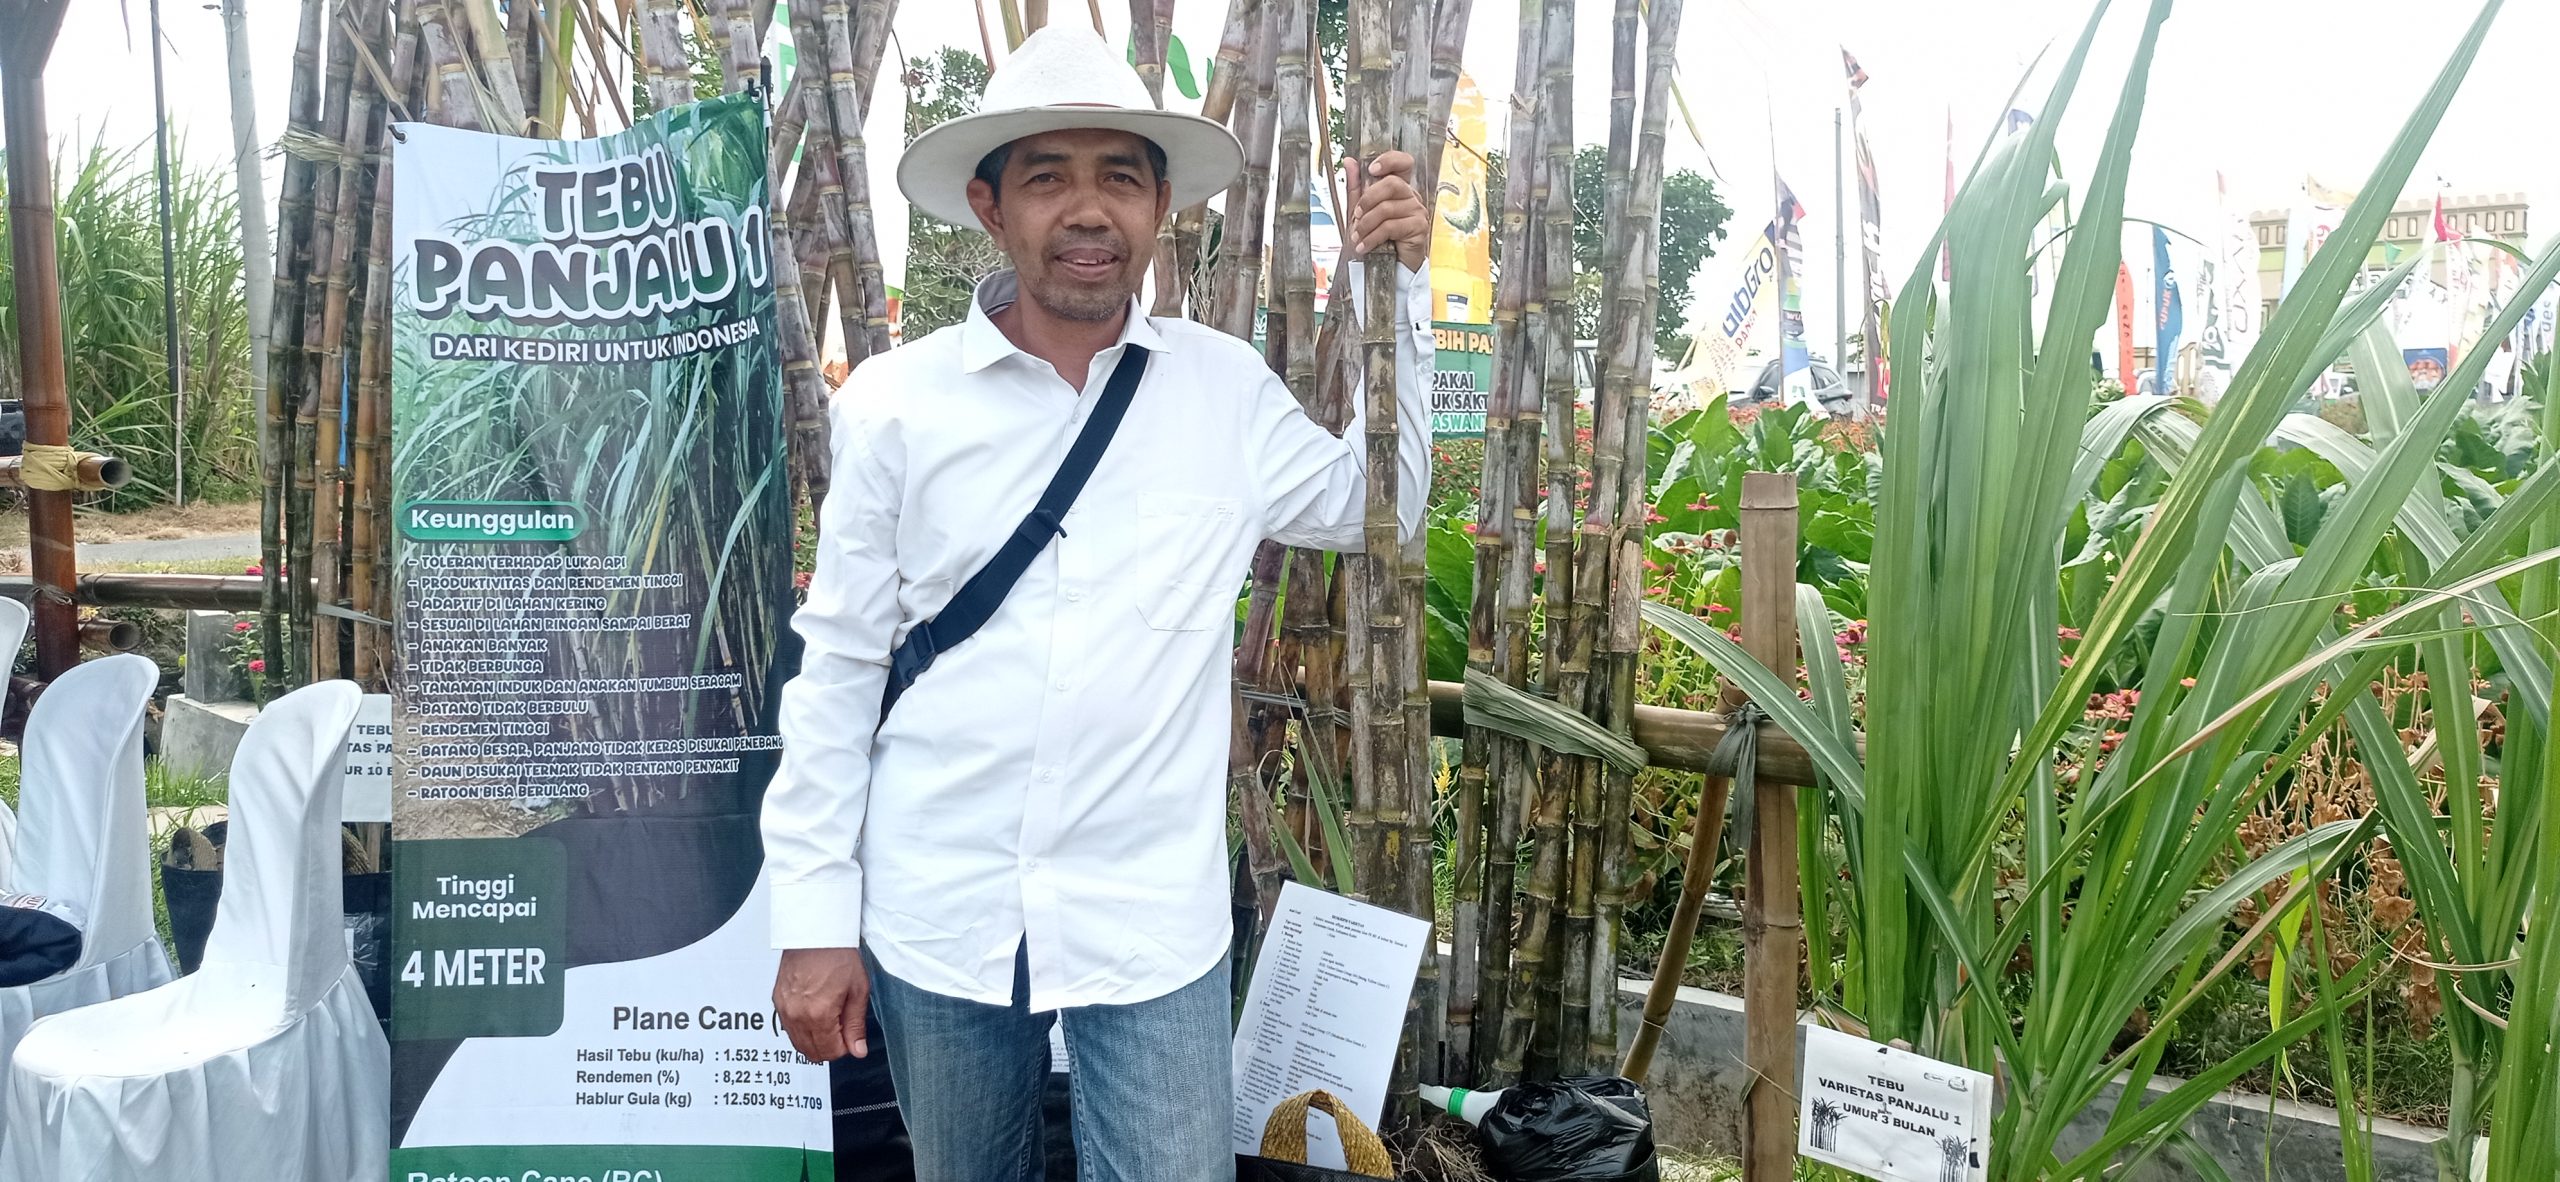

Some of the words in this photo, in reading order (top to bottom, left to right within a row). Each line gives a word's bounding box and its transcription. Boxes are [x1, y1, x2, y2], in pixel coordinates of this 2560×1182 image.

[530, 144, 678, 242] TEBU
[410, 217, 736, 320] PANJALU
[741, 205, 768, 288] 1
[433, 334, 497, 358] DARI
[503, 339, 589, 363] KEDIRI
[595, 339, 670, 362] UNTUK
[673, 319, 760, 354] INDONESIA
[411, 510, 575, 535] Keunggulan
[421, 556, 485, 570] TOLERAN
[489, 556, 562, 570] TERHADAP
[565, 556, 600, 570] LUKA
[603, 556, 627, 570] API
[421, 577, 531, 590] PRODUKTIVITAS
[534, 577, 565, 590] DAN
[568, 576, 640, 590] RENDEMEN
[643, 574, 683, 588] TINGGI
[421, 598, 483, 611] ADAPTIF
[485, 598, 500, 611] DI
[504, 598, 553, 611] LAHAN
[555, 597, 607, 611] KERING
[421, 618, 472, 631] SESUAI
[474, 618, 489, 631] DI
[494, 618, 542, 631] LAHAN
[544, 617, 599, 631] RINGAN
[602, 616, 651, 631] SAMPAI
[654, 614, 691, 629] BERAT
[421, 639, 485, 653] ANAKAN
[488, 639, 548, 652] BANYAK
[421, 661, 466, 673] TIDAK
[468, 660, 543, 673] BERBUNGA
[421, 681, 495, 695] TANAMAN
[498, 681, 542, 695] INDUK
[544, 680, 575, 694] DAN
[578, 679, 637, 693] ANAKAN
[639, 677, 688, 691] TUMBUH
[690, 673, 742, 690] SERAGAM
[420, 702, 480, 715] BATANG
[483, 701, 526, 715] TIDAK
[528, 700, 588, 714] BERBULU
[420, 723, 499, 736] RENDEMEN
[502, 722, 549, 735] TINGGI
[420, 744, 480, 757] BATANG
[483, 743, 531, 758] BESAR,
[534, 742, 602, 756] PANJANG
[605, 741, 644, 755] TIDAK
[646, 740, 685, 754] KERAS
[688, 738, 733, 752] DISUKAI
[734, 735, 784, 750] PENEBANG
[367, 767, 383, 775] 10
[420, 765, 463, 778] DAUN
[466, 764, 521, 778] DISUKAI
[524, 764, 579, 777] TERNAK
[582, 763, 623, 776] TIDAK
[625, 760, 682, 775] RENTANG
[685, 758, 740, 774] PENYAKIT
[420, 786, 479, 800] RATOON
[481, 786, 515, 799] BISA
[517, 784, 589, 799] BERULANG
[436, 873, 514, 900] Tinggi
[412, 897, 537, 923] Mencapai
[401, 950, 424, 988] 4
[434, 947, 546, 986] METER
[613, 1006, 690, 1031] Plane
[698, 1006, 764, 1031] Cane
[577, 1049, 613, 1062] Hasil
[617, 1049, 651, 1062] Tebu
[655, 1048, 704, 1064] (ku/ha)
[723, 1049, 758, 1062] 1.532
[774, 1050, 792, 1063] 197
[576, 1071, 652, 1083] Rendemen
[657, 1071, 680, 1086] (%)
[723, 1071, 751, 1086] 8,22
[766, 1072, 791, 1086] 1,03
[1867, 1075, 1905, 1092] TEBU
[576, 1092, 624, 1105] Hablur
[627, 1092, 660, 1105] Gula
[665, 1092, 692, 1108] (kg)
[723, 1093, 765, 1106] 12.503
[1818, 1077, 1884, 1103] VARIETAS
[1888, 1095, 1949, 1121] PANJALU
[1954, 1115, 1962, 1126] 1
[1843, 1102, 1878, 1121] UMUR
[1881, 1114, 1889, 1124] 3
[1893, 1119, 1936, 1137] BULAN
